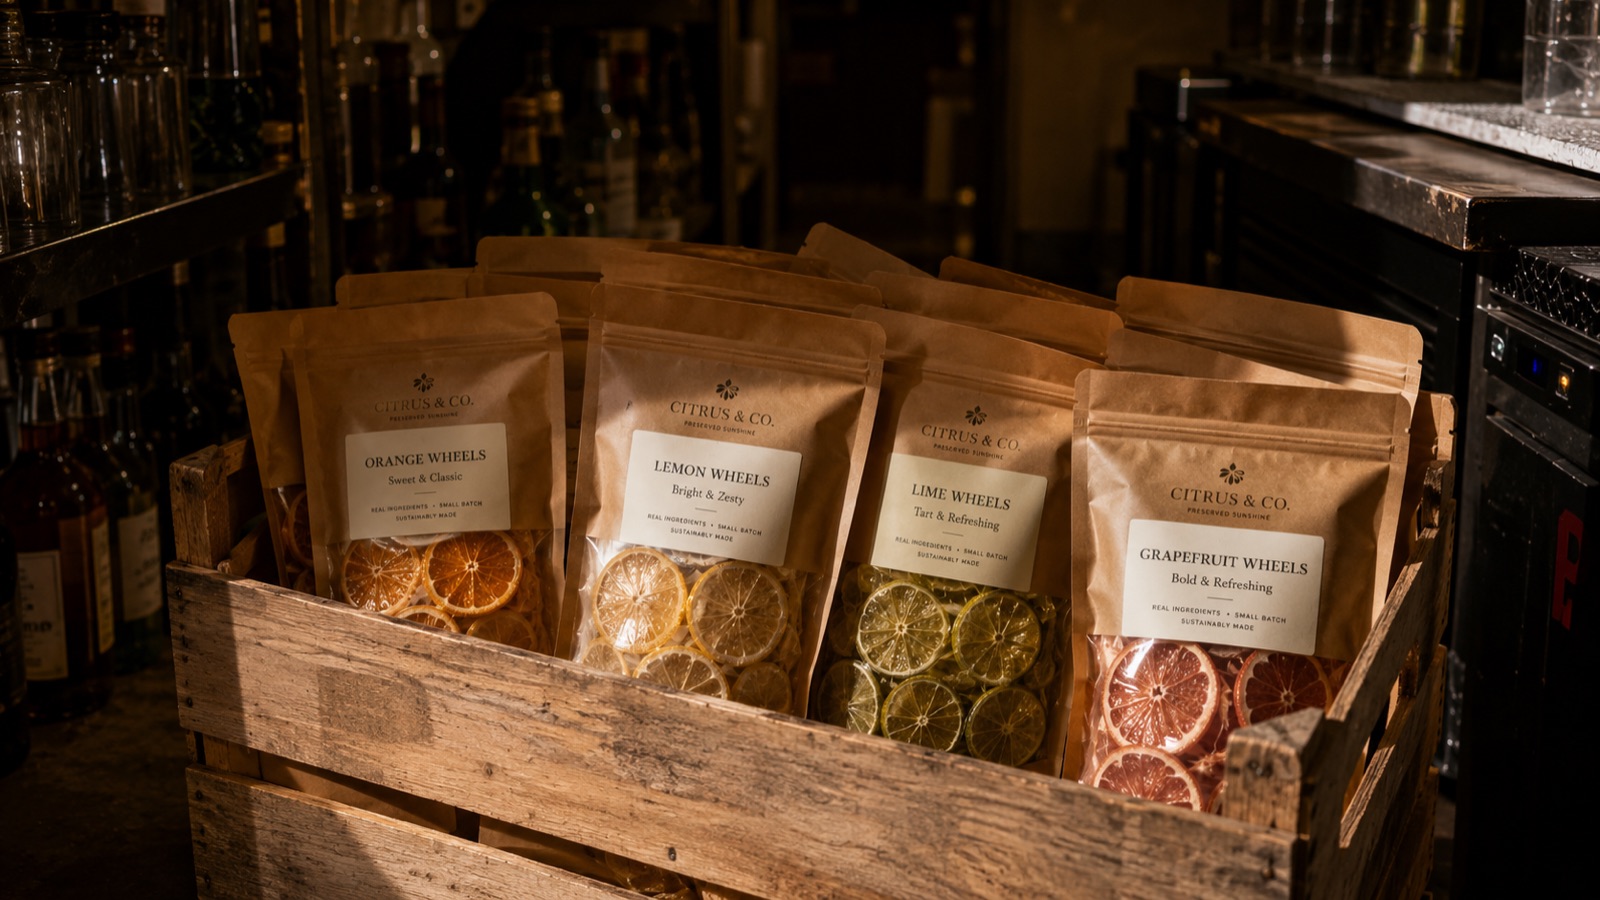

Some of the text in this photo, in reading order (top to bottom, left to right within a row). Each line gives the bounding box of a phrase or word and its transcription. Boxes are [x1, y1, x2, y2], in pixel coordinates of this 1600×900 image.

[374, 394, 474, 413] CITRUS & CO.
[670, 400, 775, 427] CITRUS & CO.
[684, 420, 756, 436] PRESERVED SUNSHINE
[921, 424, 1021, 452] CITRUS & CO.
[365, 449, 487, 469] ORANGE WHEELS
[388, 472, 463, 485] Sweet & Classic
[654, 460, 770, 488] LEMON WHEELS
[439, 501, 459, 509] SMALL
[672, 484, 745, 506] Bright & Zesty
[912, 483, 1011, 511] LIME WHEELS
[1171, 487, 1290, 512] CITRUS & CO.
[395, 513, 436, 521] SUSTAINABLY
[647, 513, 762, 536] REAL INGREDIENTS SMALL BATCH
[914, 506, 1000, 533] Tart & Refreshing
[1187, 507, 1271, 521] PRESERVED SUNSHINE
[670, 527, 733, 542] SUSTAINABLY MADE
[895, 536, 910, 544] REAL
[963, 548, 984, 557] SMALL
[986, 551, 1008, 561] BATCH
[961, 559, 980, 567] MADE
[1140, 548, 1308, 576] GRAPEFRUIT WHEELS
[1171, 572, 1273, 595] Bold & Refreshing
[1152, 604, 1287, 624] REAL INGREDIENTS SMALL BATCH
[1181, 618, 1254, 631] SUSTAINABLY MADE
